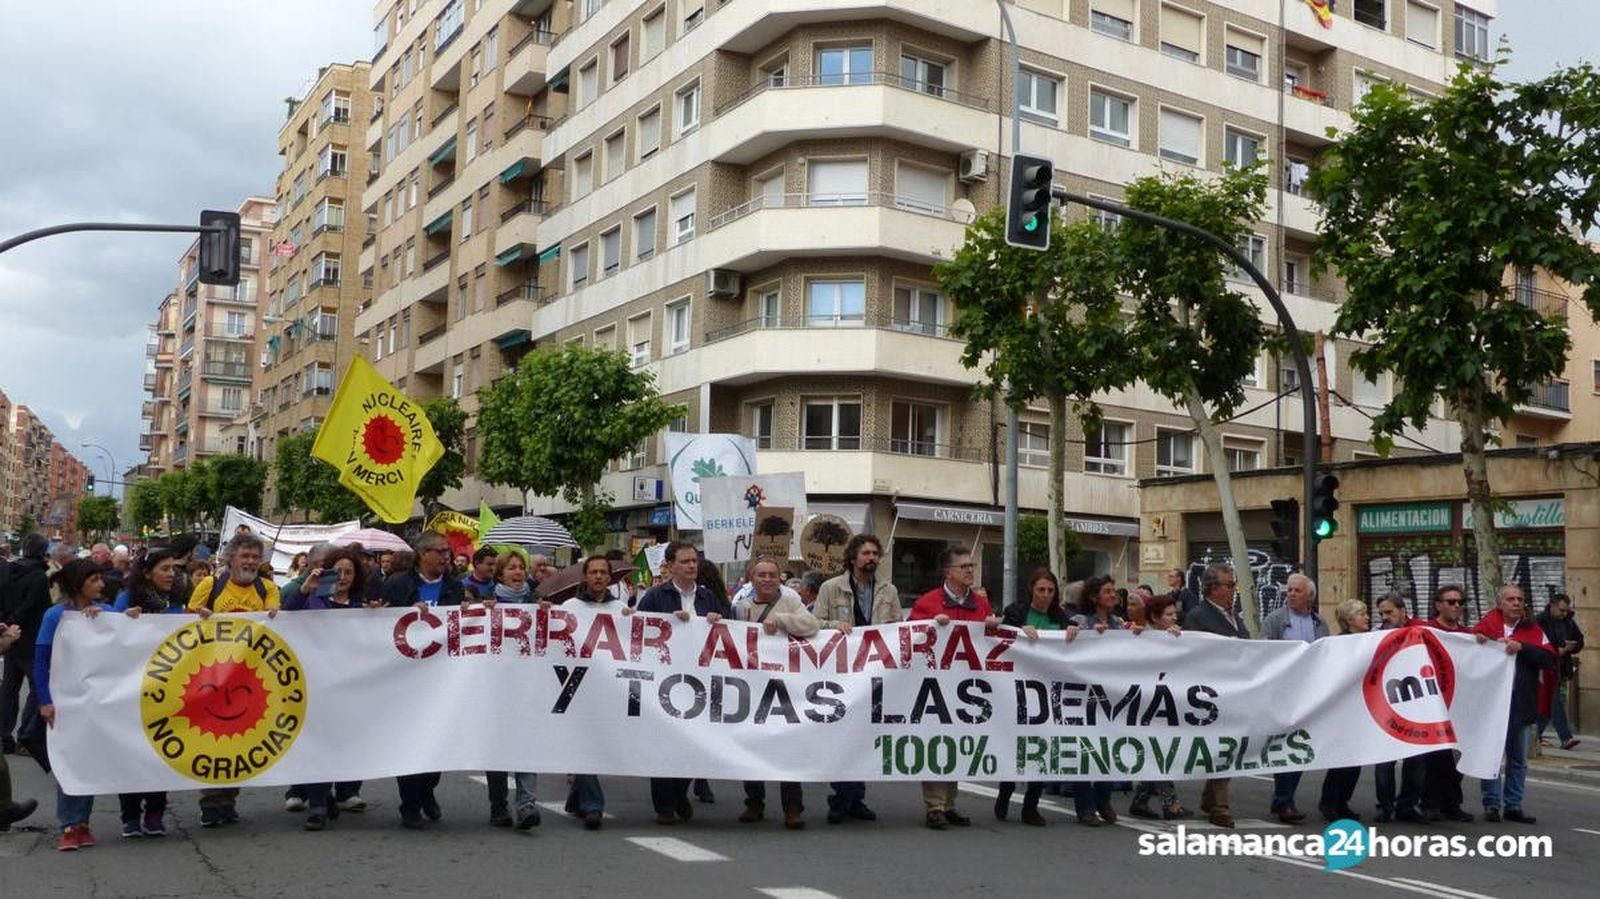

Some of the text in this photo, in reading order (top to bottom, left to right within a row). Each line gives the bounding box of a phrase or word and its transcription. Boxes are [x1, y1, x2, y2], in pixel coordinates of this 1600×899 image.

[352, 464, 405, 486] MERCI
[1359, 508, 1449, 529] ALIMENTACION
[393, 606, 1018, 674] CERRAR ALMARAZ
[551, 664, 1220, 727] Y TODAS LAS DEMÁS
[1386, 665, 1439, 705] mi
[147, 712, 299, 779] NO GRACIAS
[873, 734, 998, 777] 100%
